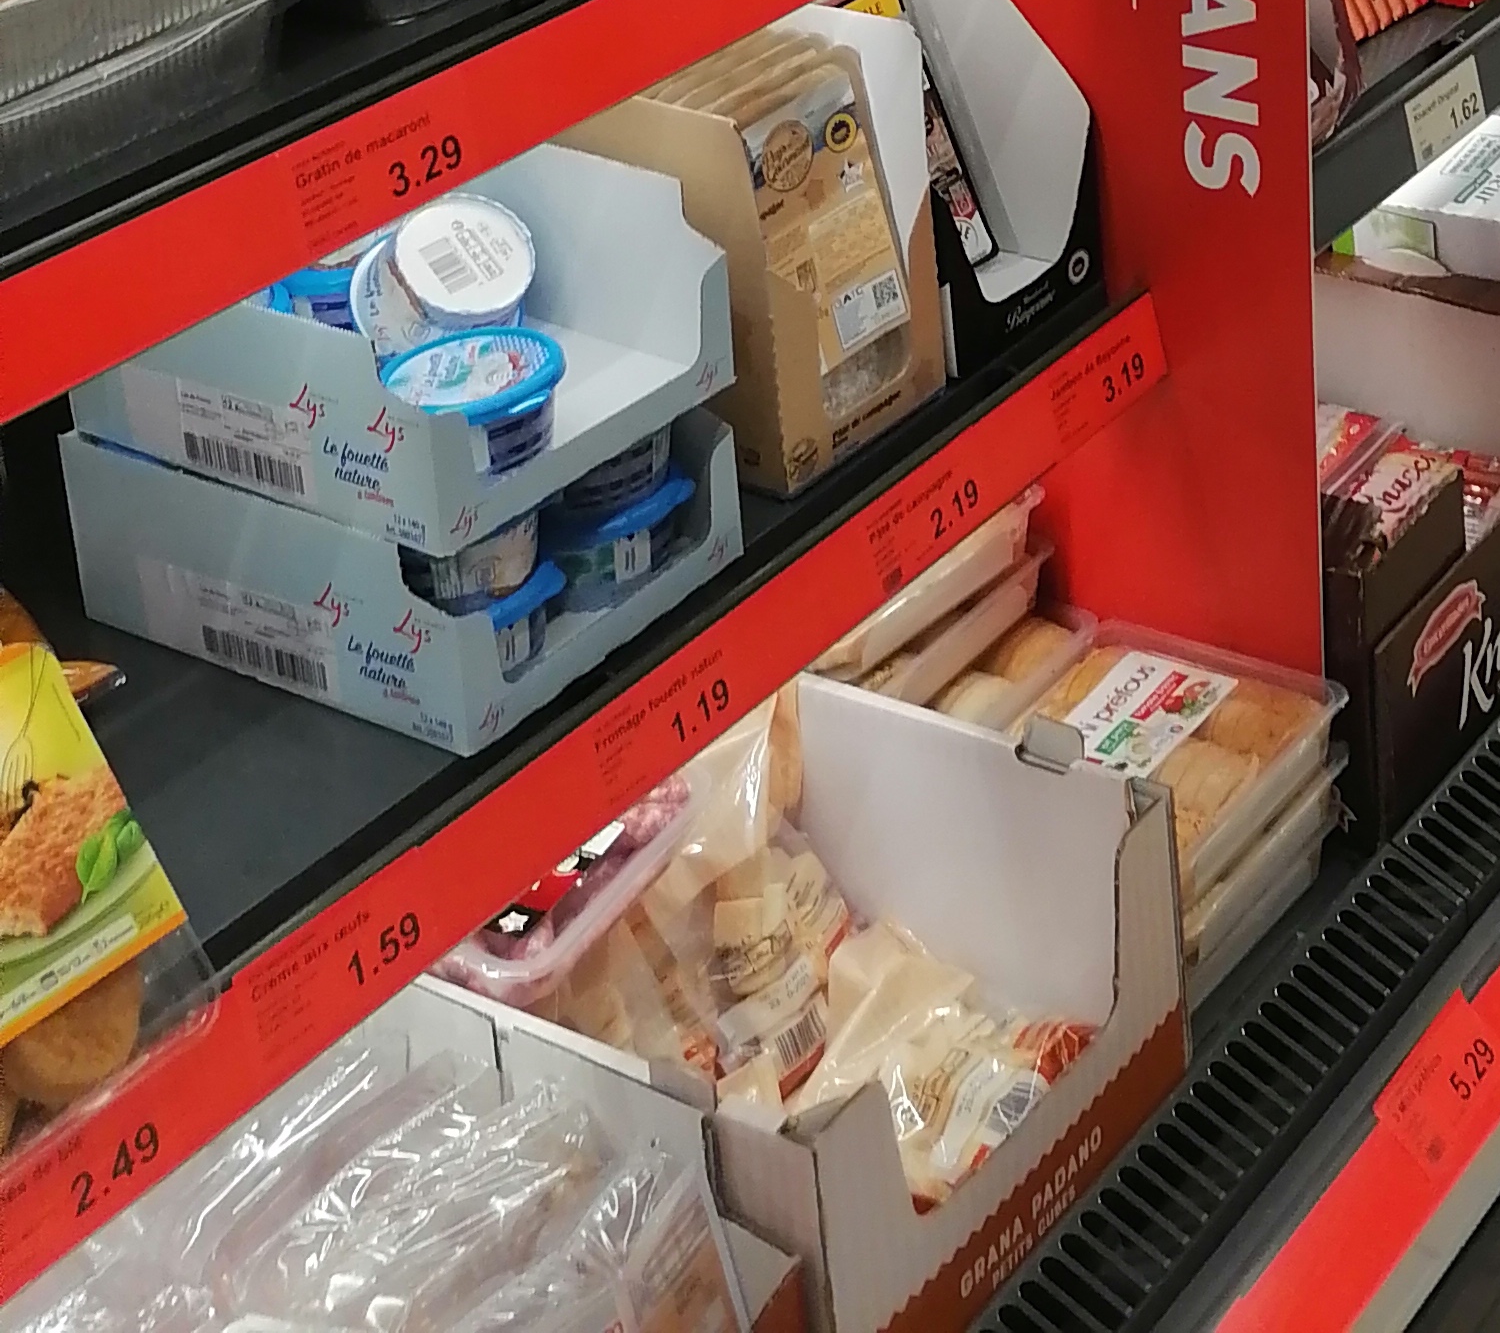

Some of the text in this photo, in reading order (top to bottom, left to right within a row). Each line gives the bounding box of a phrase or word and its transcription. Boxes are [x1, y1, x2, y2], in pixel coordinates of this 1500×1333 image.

[1448, 91, 1481, 130] 1.62
[294, 110, 432, 190] Gratin de macaroni
[387, 133, 463, 198] 3.29
[1101, 352, 1145, 403] 3.19
[289, 382, 326, 430] Lys
[366, 405, 406, 455] Lys
[322, 435, 391, 474] Le fouetté
[333, 466, 382, 492] nature
[929, 478, 980, 541] 2.19
[312, 580, 351, 629] Lys
[347, 633, 416, 673] Le fouetté
[392, 608, 432, 655] Lys
[358, 664, 408, 689] nature
[670, 677, 731, 744] 1.19
[346, 911, 421, 988] 1.59
[1449, 1039, 1495, 1101] 5.29
[69, 1121, 160, 1220] 2.49
[960, 1123, 1104, 1302] GRANA PADANO
